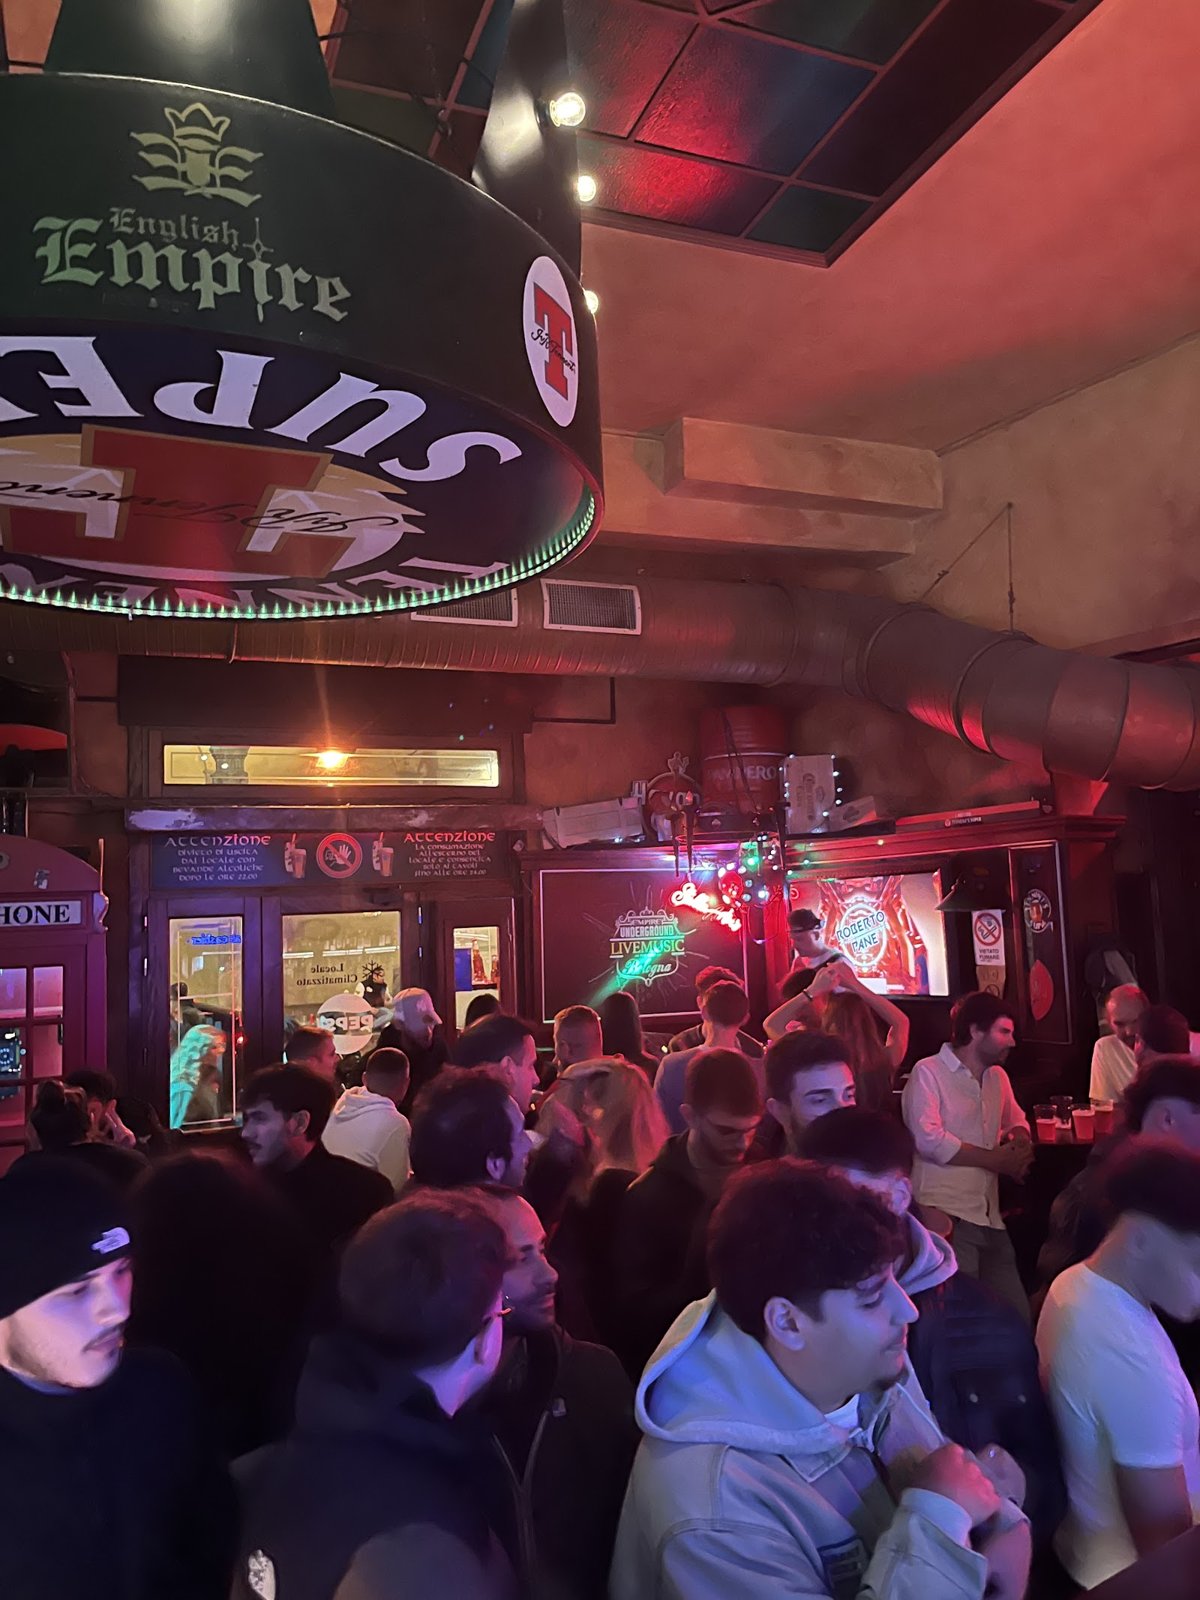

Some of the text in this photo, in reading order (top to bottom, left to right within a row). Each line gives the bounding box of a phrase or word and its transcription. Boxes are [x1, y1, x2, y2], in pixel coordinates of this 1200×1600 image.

[110, 207, 239, 250] English
[32, 216, 351, 322] Empire
[0, 336, 523, 482] SUPE
[164, 833, 271, 848] ATTENZIONE
[404, 830, 496, 843] ATTENZIONE
[620, 925, 674, 938] UNDERGROUND
[836, 911, 885, 940] ROBERTO
